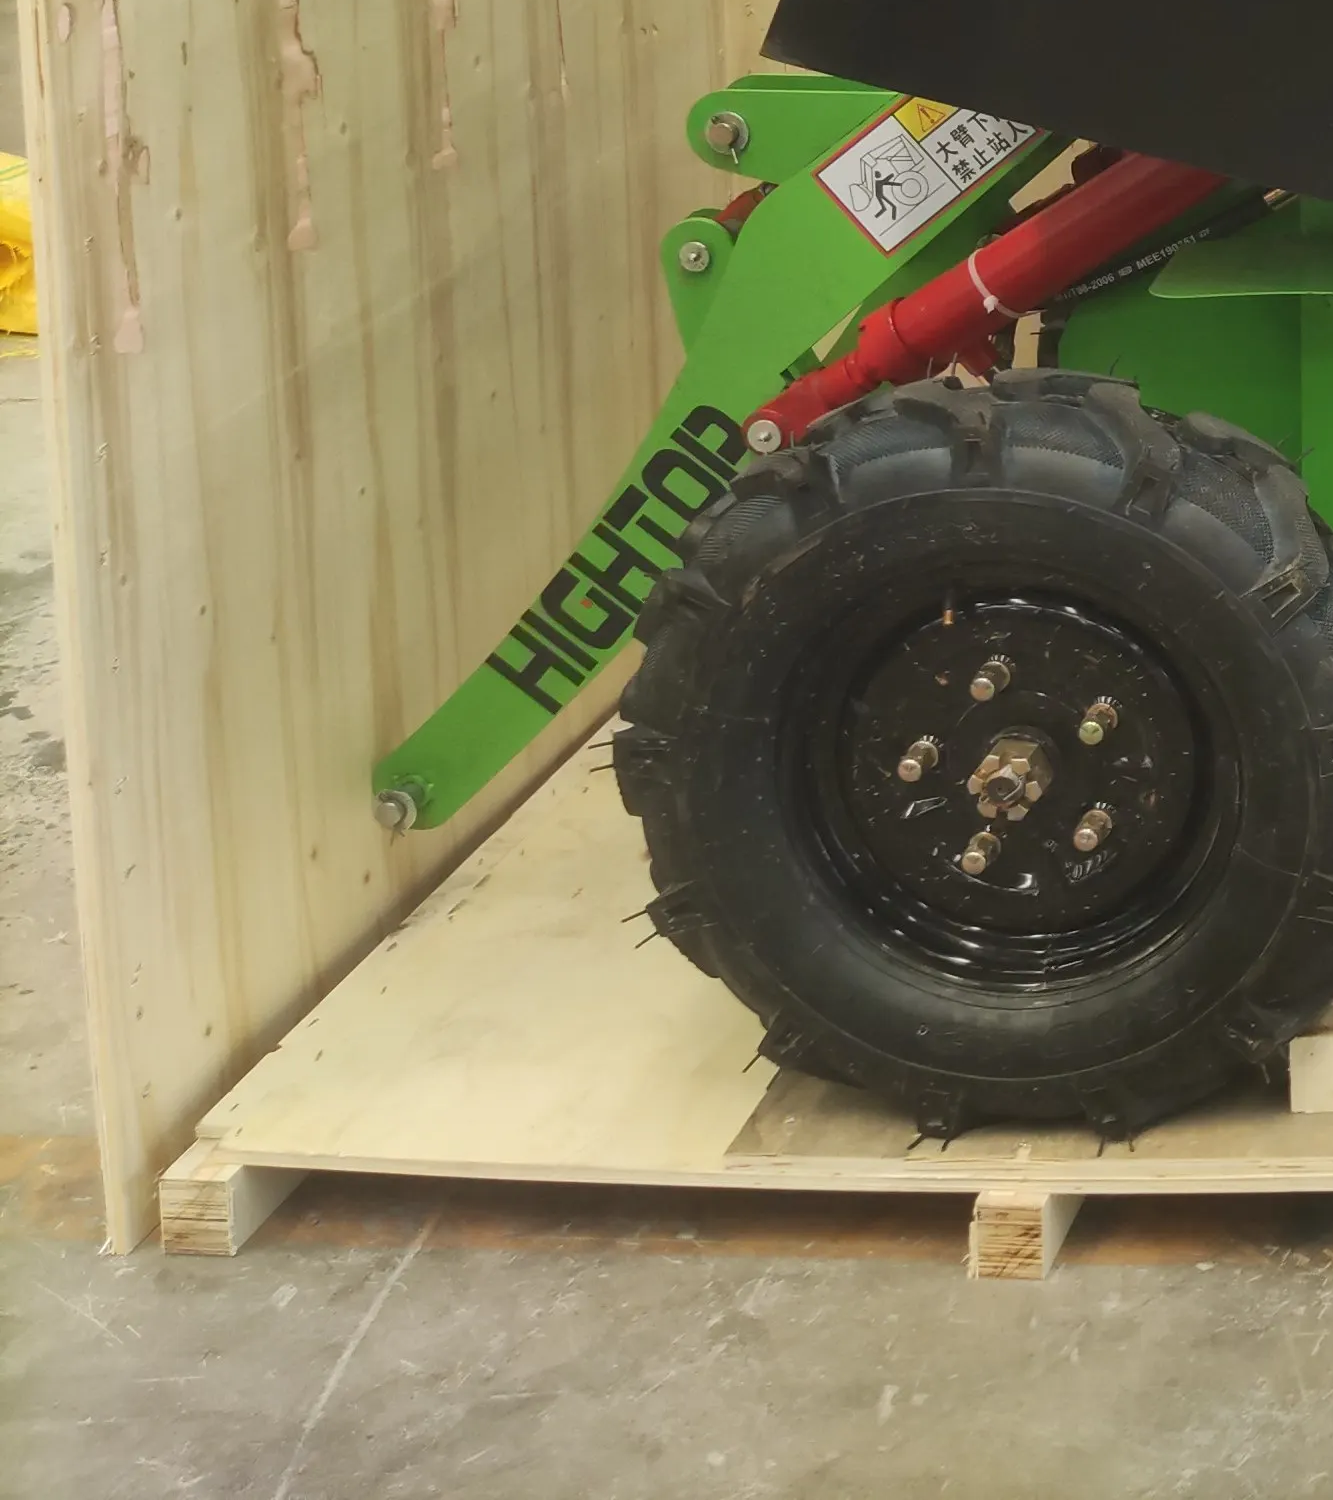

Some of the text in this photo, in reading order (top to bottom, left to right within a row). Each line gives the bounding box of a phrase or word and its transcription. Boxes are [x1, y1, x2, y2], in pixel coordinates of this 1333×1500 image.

[935, 111, 1000, 163] 大臂下
[951, 120, 1028, 184] 禁止站人
[485, 405, 749, 716] HIGHTOP
